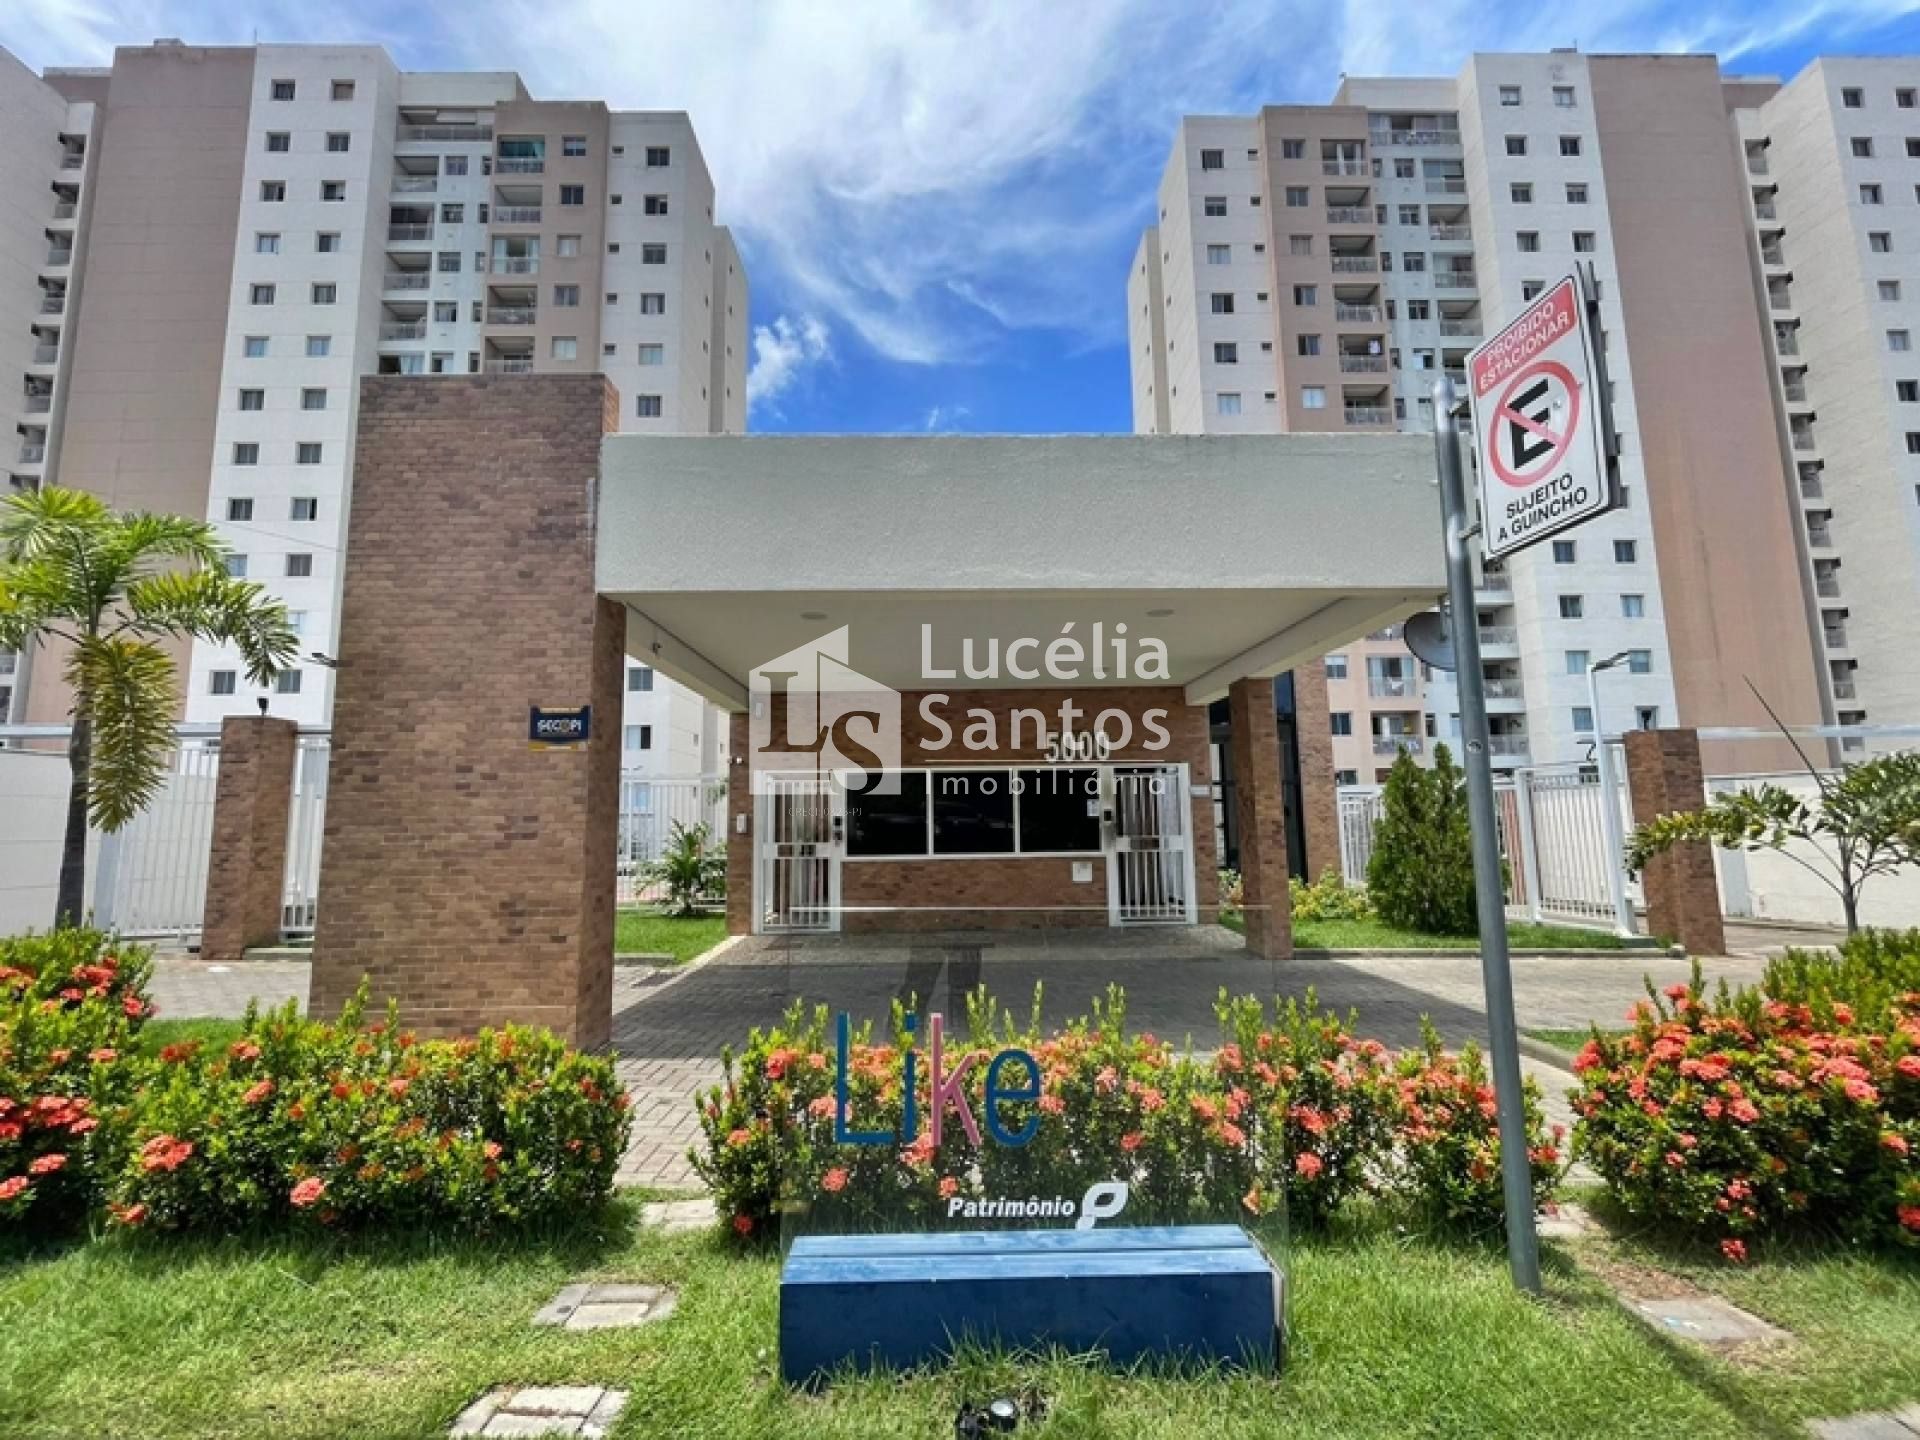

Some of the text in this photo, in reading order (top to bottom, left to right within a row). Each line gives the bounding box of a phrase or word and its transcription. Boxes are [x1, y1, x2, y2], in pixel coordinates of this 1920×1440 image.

[1481, 311, 1569, 390] ESTACIONAR
[1487, 302, 1553, 366] PROIBIDO
[1497, 486, 1587, 543] A GUINCHO
[1506, 472, 1573, 519] SUJEITO
[835, 1010, 1041, 1147] Like
[947, 1195, 1075, 1218] Patrimônio
